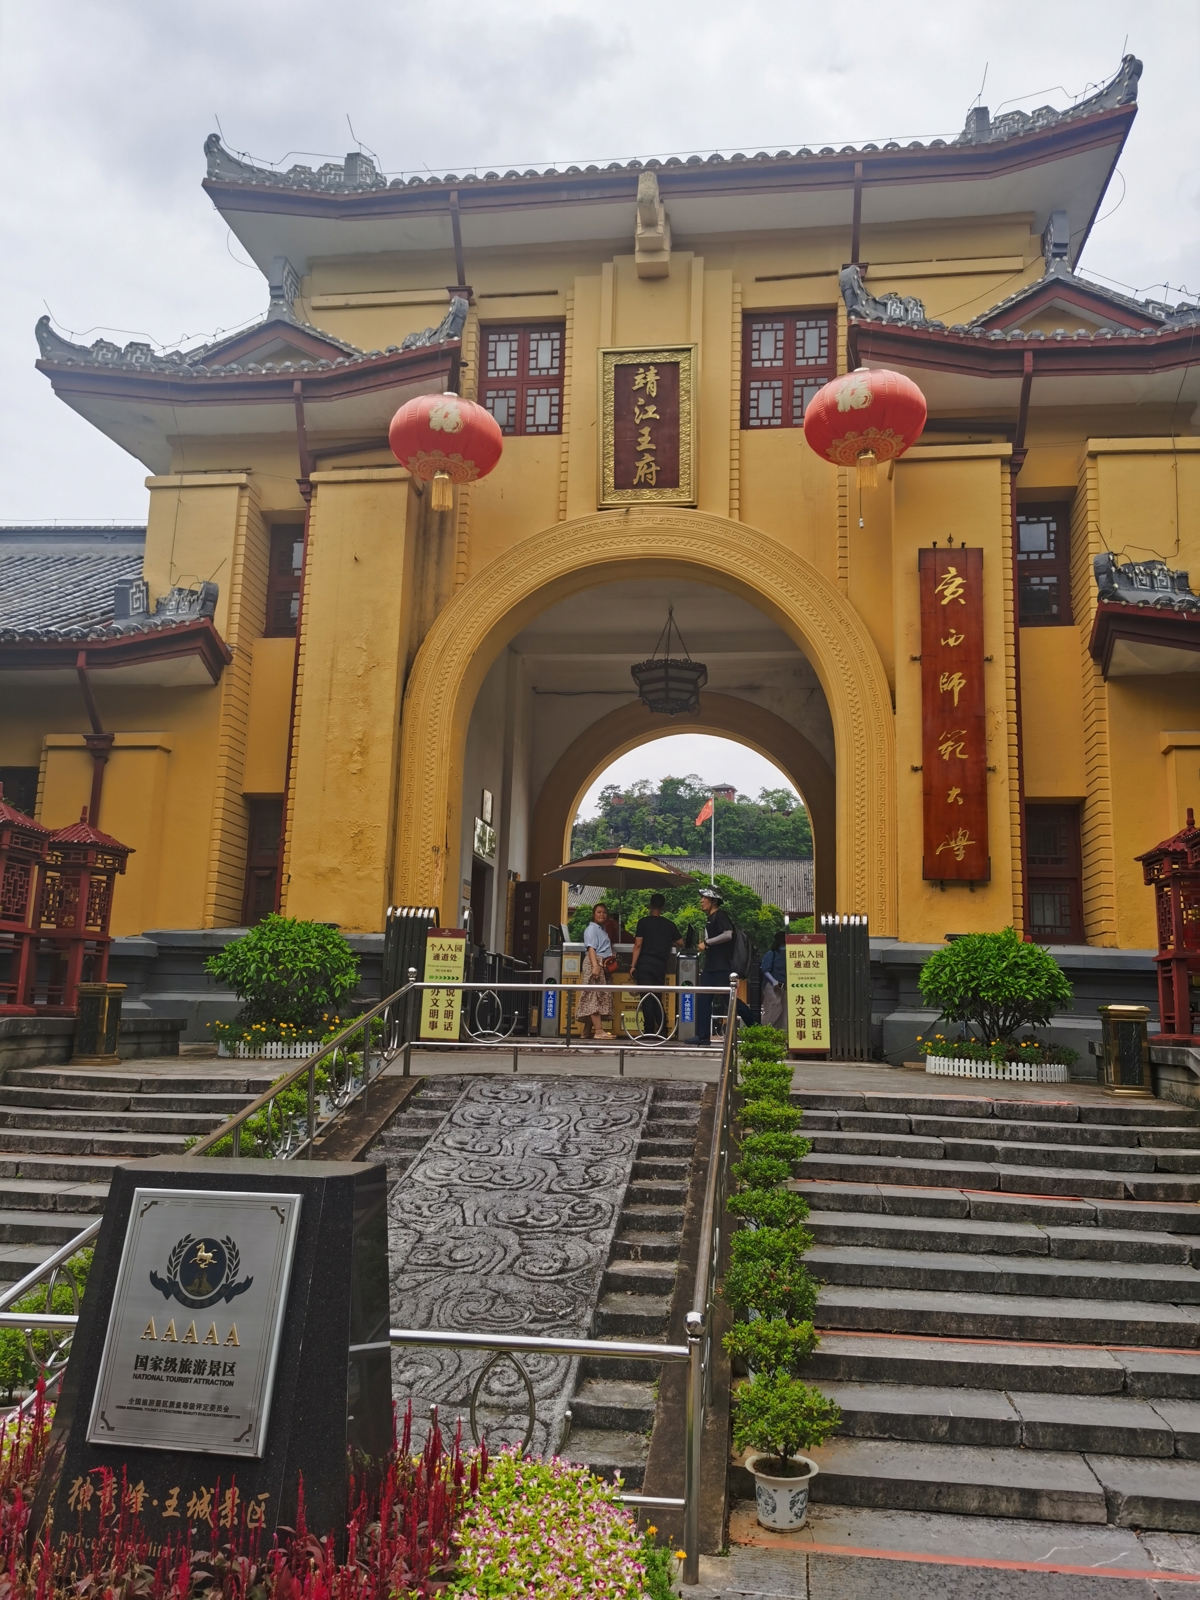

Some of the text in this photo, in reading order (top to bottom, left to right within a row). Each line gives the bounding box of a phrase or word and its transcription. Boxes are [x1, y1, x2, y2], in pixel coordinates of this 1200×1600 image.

[631, 365, 661, 487] 靖江王府
[429, 943, 463, 953] 个人入园
[789, 950, 824, 959] 团队入园
[432, 953, 458, 962] 通道处
[793, 960, 820, 969] 通道处
[795, 994, 806, 1041] 办文明事
[811, 994, 823, 1041] 说文明话
[133, 1354, 237, 1377] 国家级旅游景区
[132, 1373, 235, 1387] NATIONAL TOURIST ATTRACTION
[128, 1397, 230, 1413] 全国旅游景区质量等级评定委员会
